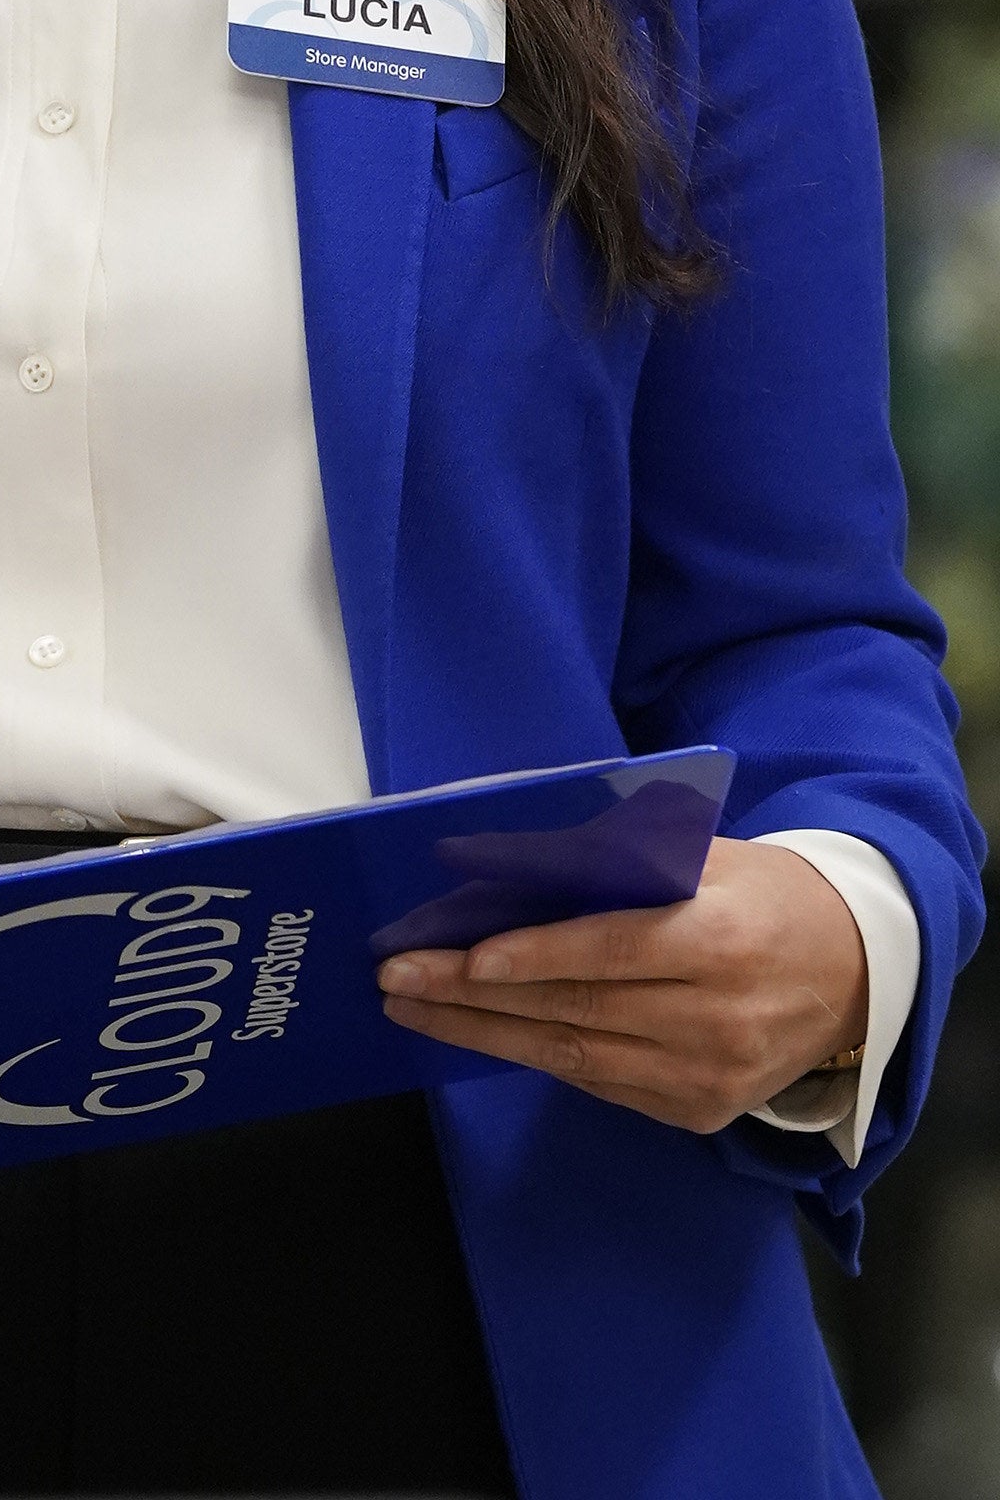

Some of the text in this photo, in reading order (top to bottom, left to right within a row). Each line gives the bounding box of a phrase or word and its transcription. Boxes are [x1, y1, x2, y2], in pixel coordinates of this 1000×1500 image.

[305, 47, 426, 81] Store Manager
[230, 908, 315, 1042] Superstore
